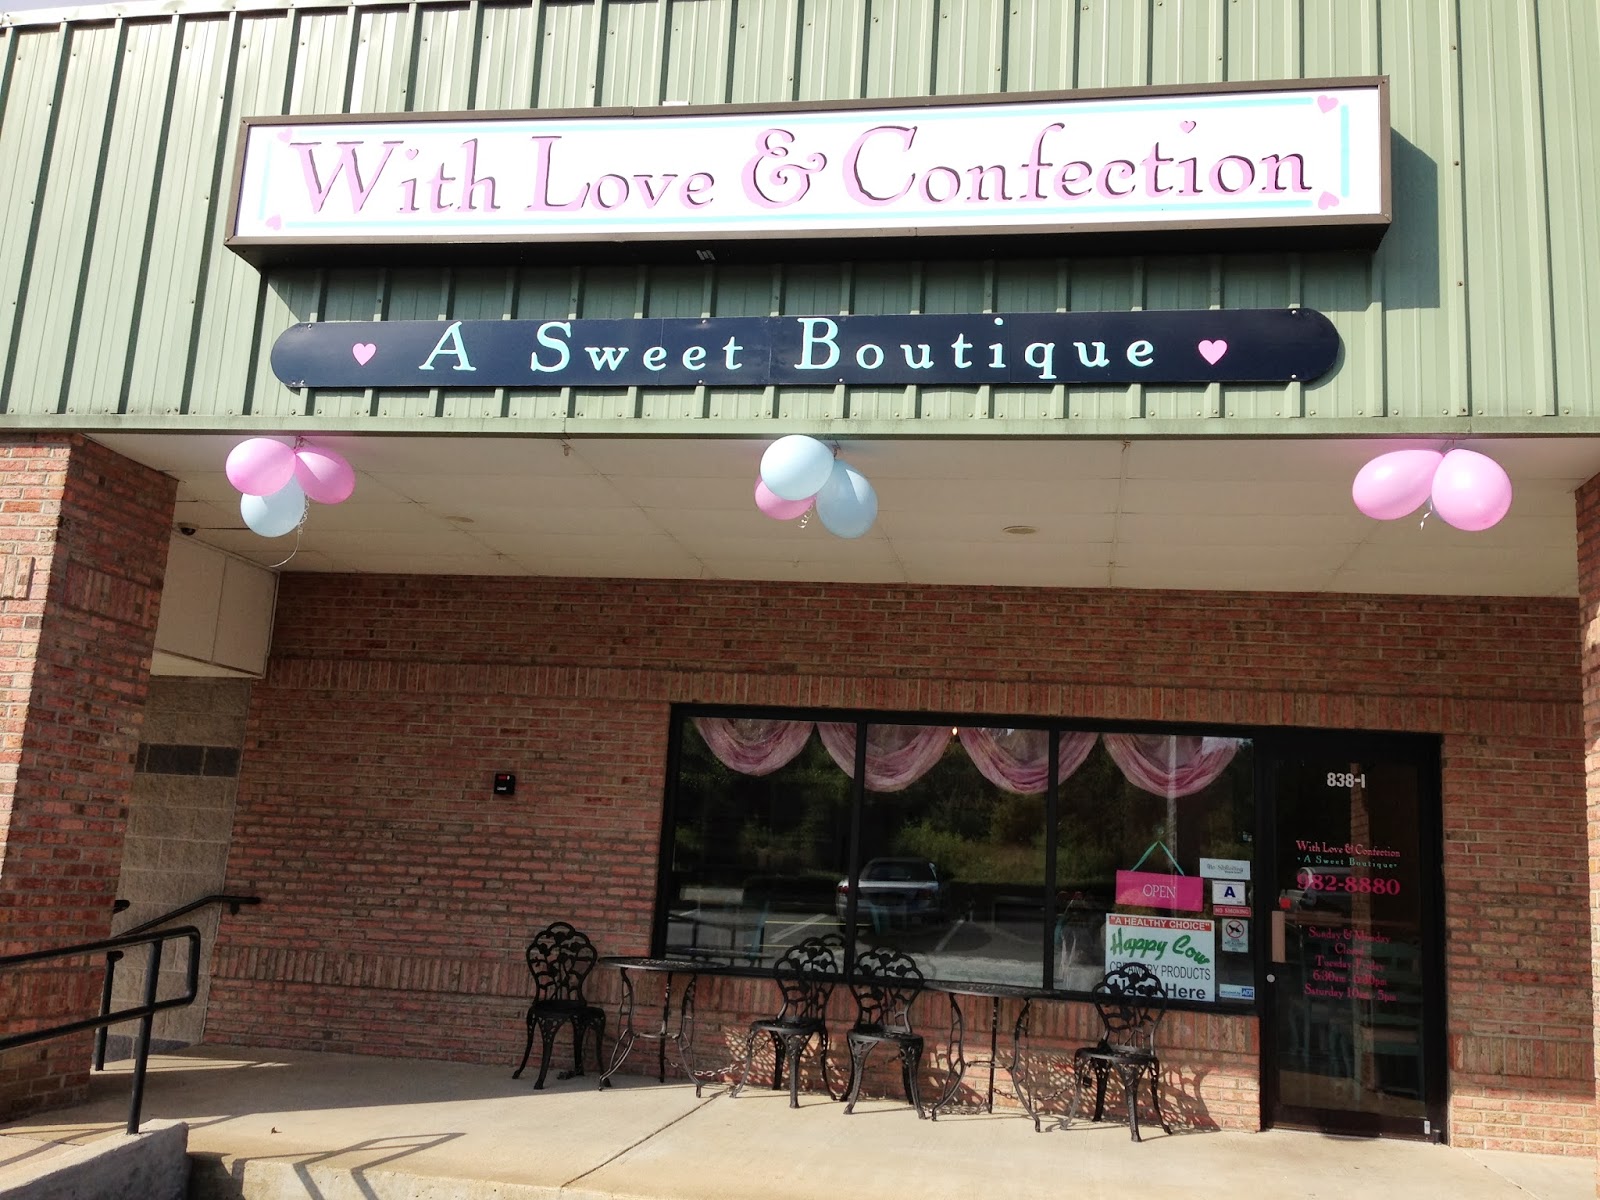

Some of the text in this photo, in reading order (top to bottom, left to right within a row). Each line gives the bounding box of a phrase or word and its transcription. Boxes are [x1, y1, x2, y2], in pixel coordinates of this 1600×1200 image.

[288, 119, 1312, 214] With Love & Confection
[418, 316, 1156, 380] A Sweet Boutique
[1296, 840, 1320, 853] With
[1355, 844, 1401, 857] Confection
[1303, 855, 1311, 863] A
[1315, 856, 1344, 865] Sweet
[1142, 883, 1176, 899] OPEN
[1224, 886, 1236, 898] A
[1296, 873, 1400, 895] 982-8880
[1124, 917, 1166, 927] HEALTHY
[1110, 927, 1210, 965] Happy Cow
[1161, 965, 1211, 981] PRODUCTS
[1166, 982, 1206, 999] Here
